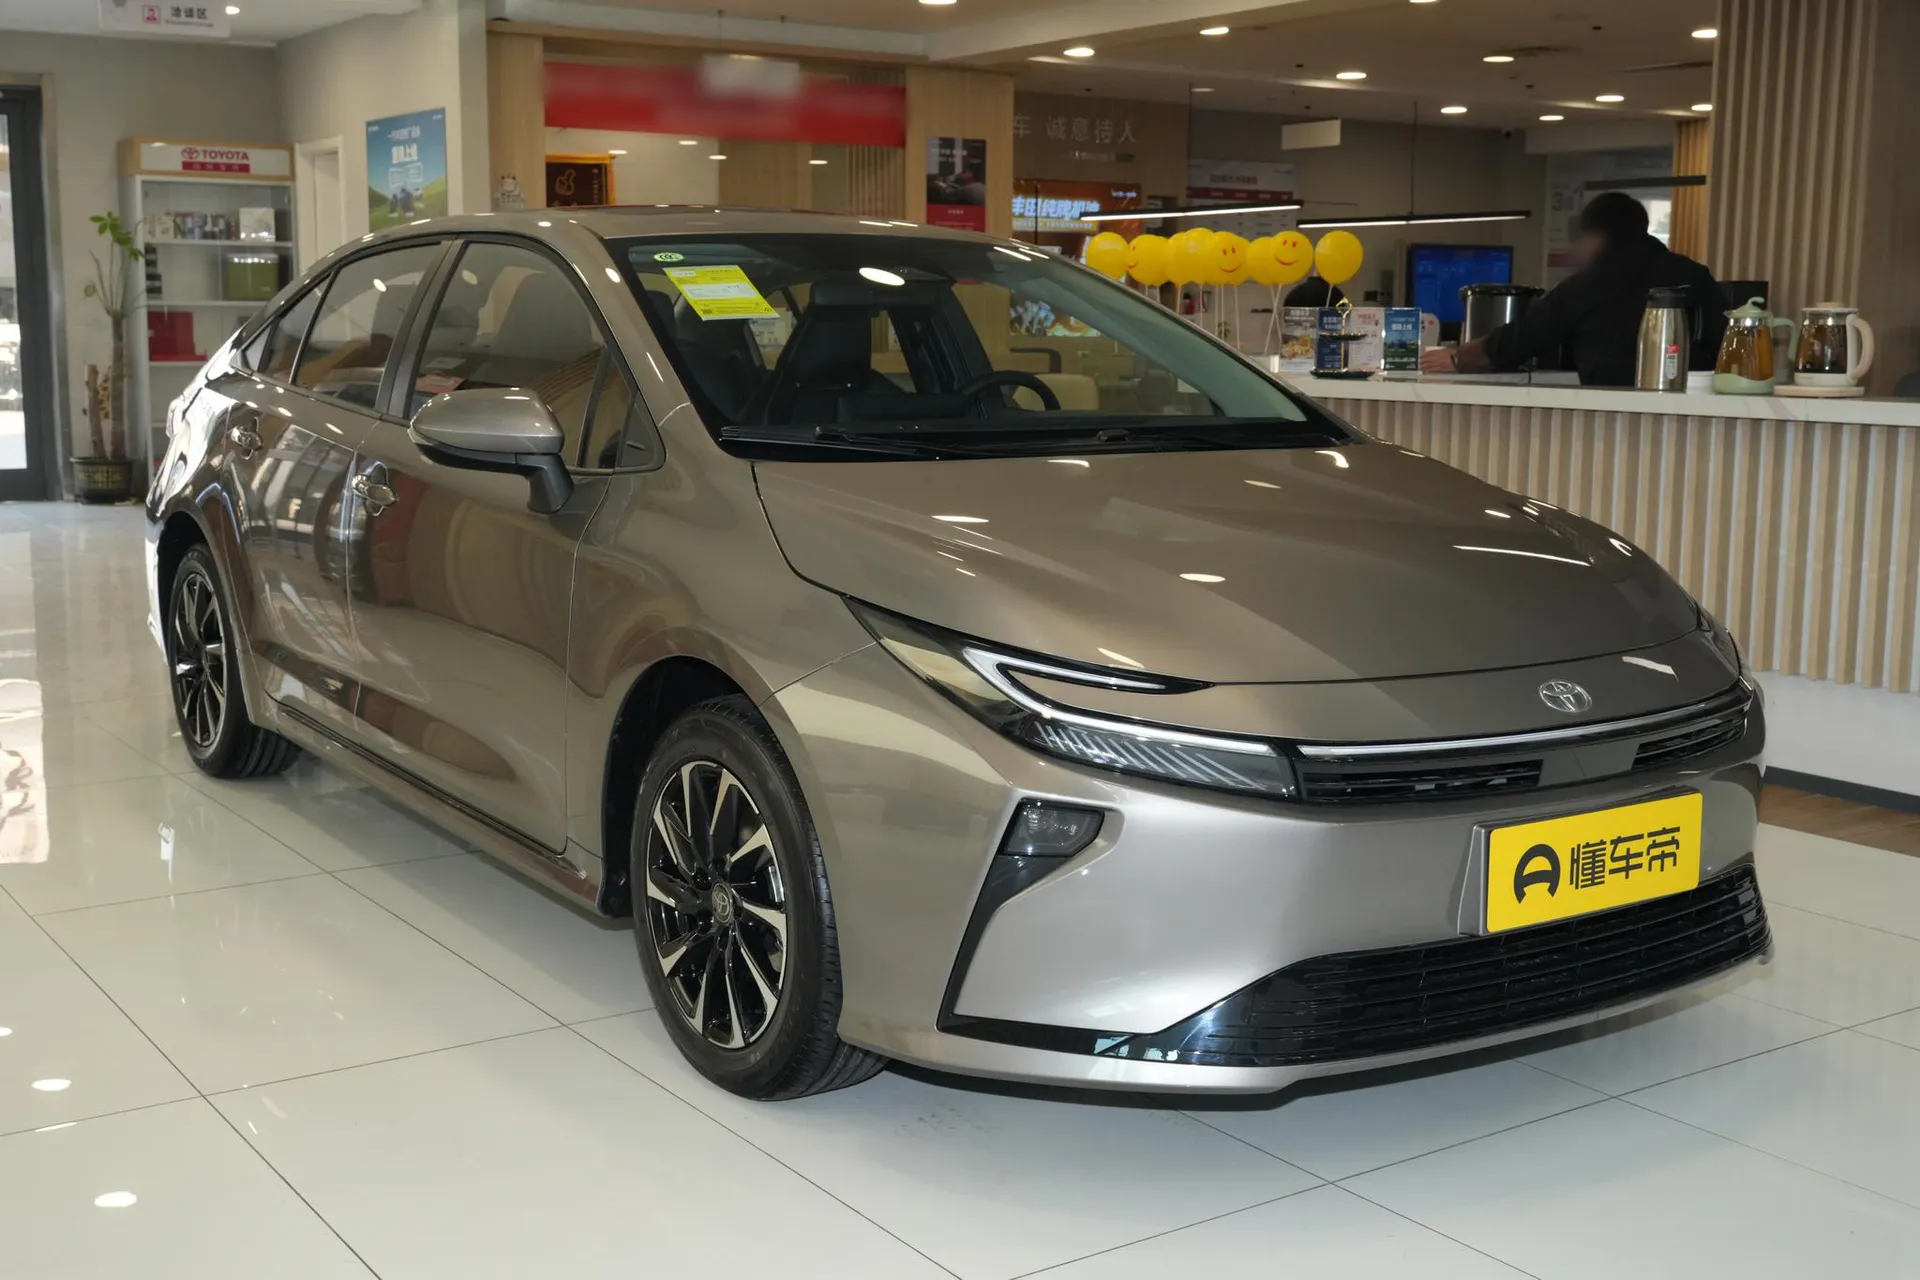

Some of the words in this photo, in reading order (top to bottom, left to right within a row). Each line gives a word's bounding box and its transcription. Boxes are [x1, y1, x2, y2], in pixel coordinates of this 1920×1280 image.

[201, 149, 250, 161] TOYOTA
[1569, 826, 1681, 890] 懂车帝
